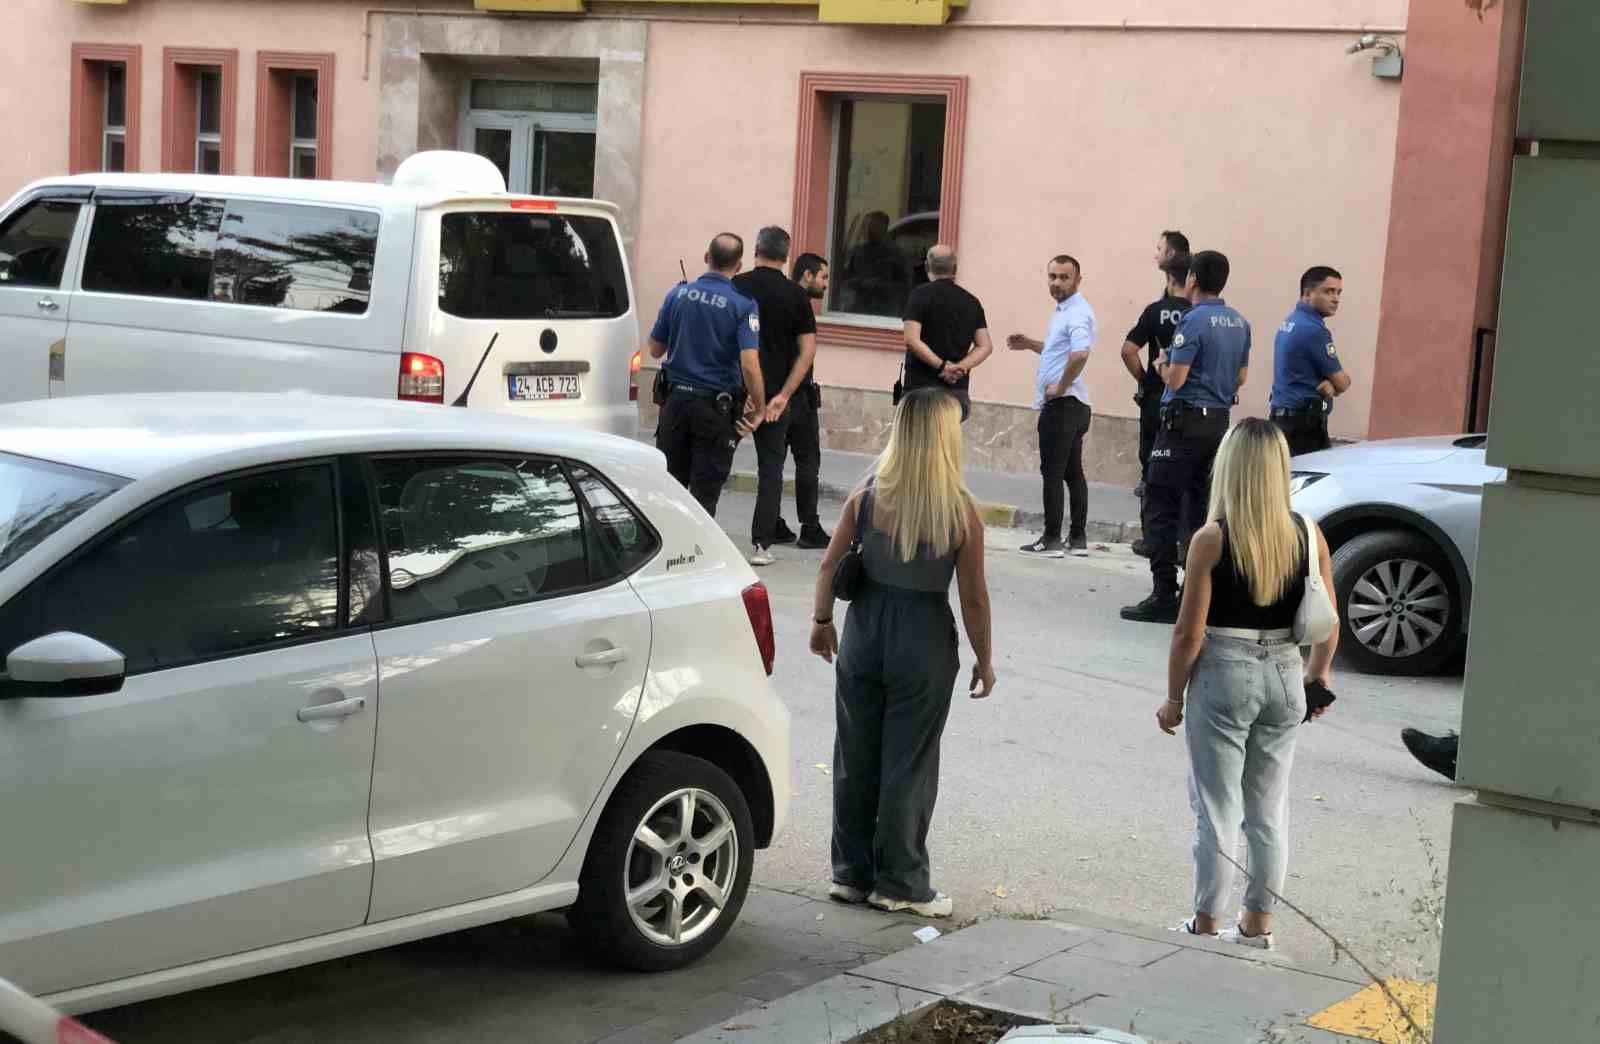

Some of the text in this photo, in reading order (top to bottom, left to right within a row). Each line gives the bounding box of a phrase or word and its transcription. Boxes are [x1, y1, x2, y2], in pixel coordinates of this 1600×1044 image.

[517, 376, 578, 393] 24 ACB 723
